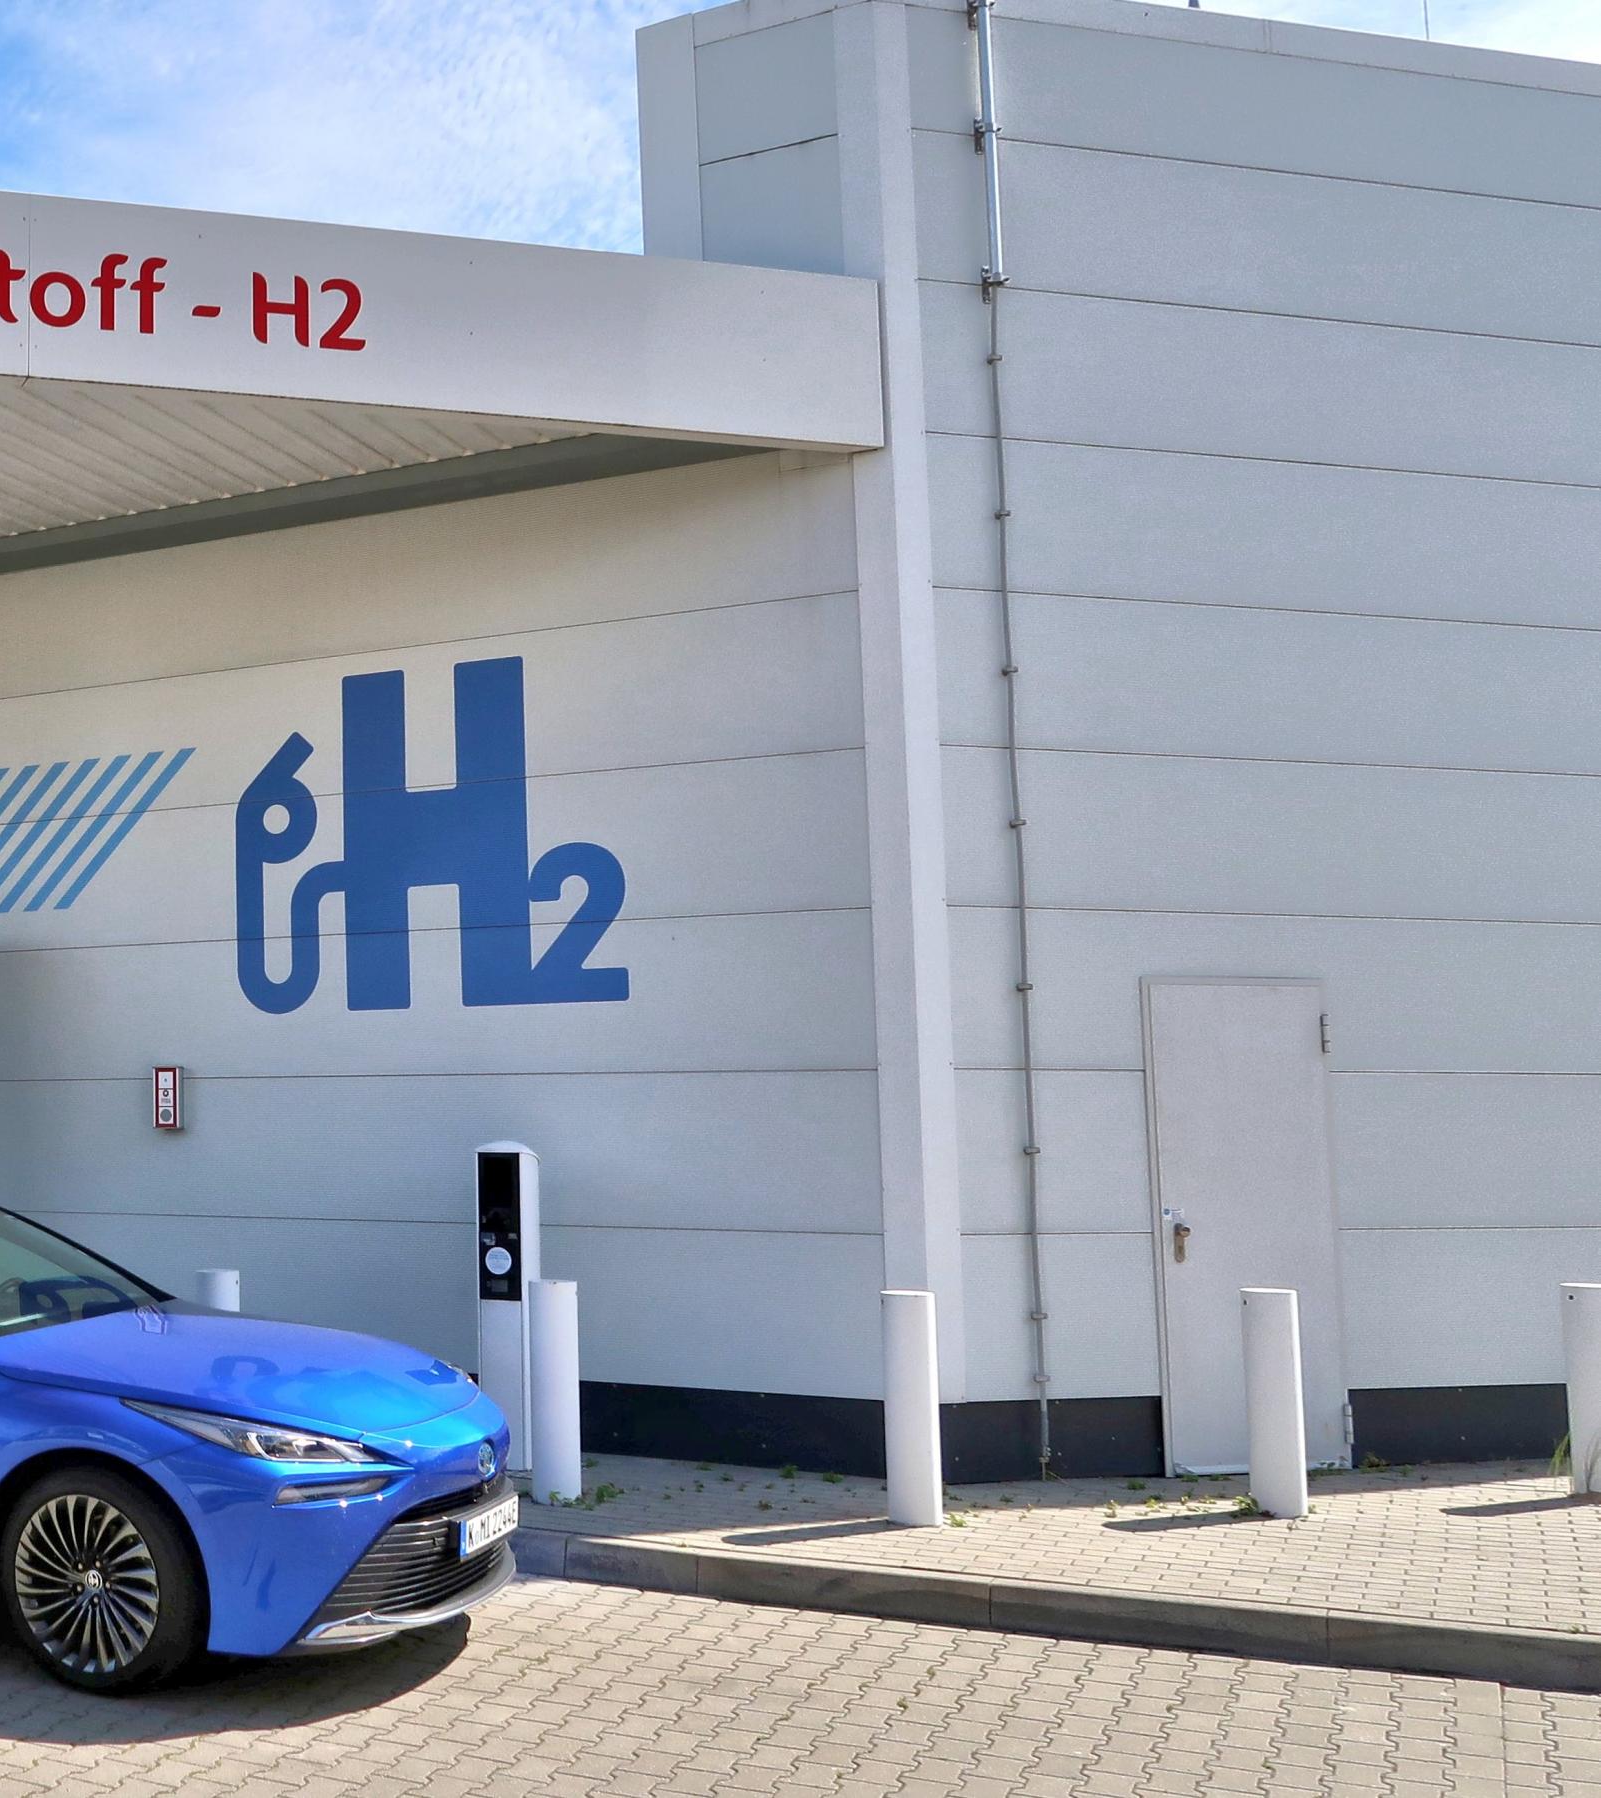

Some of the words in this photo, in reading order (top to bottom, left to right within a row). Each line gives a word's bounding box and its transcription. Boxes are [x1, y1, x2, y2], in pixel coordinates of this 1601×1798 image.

[251, 271, 367, 352] H2
[341, 656, 630, 1011] H2
[468, 1522, 475, 1548] K
